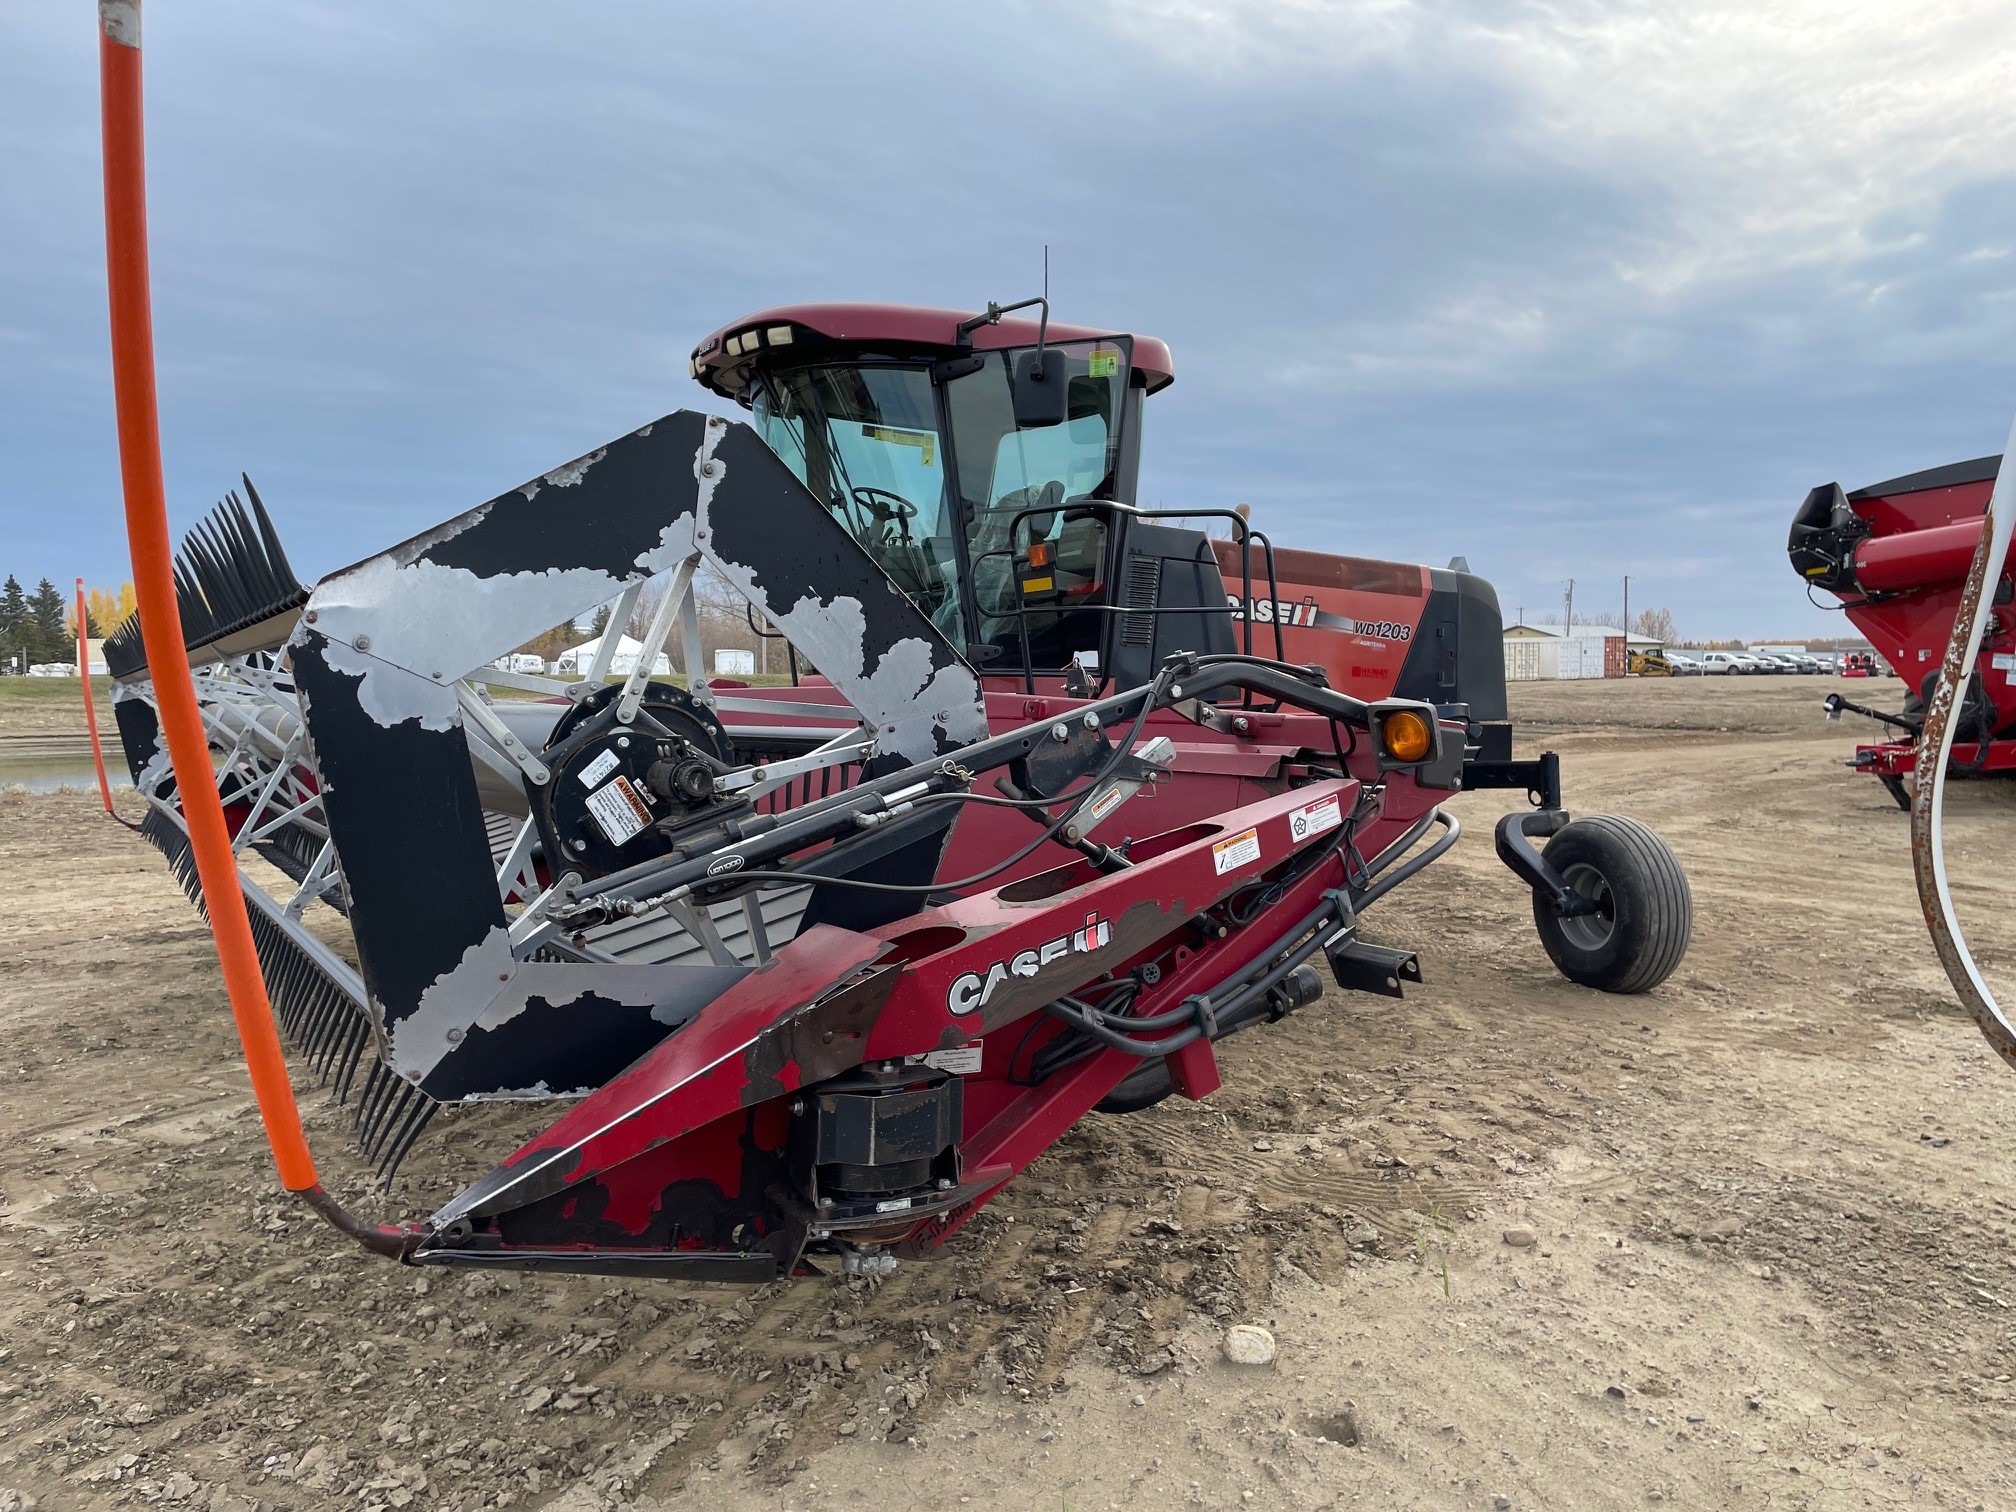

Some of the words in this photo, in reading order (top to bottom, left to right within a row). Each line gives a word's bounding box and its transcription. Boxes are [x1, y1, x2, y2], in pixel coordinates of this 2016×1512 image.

[1354, 620, 1411, 642] WD1203
[621, 785, 650, 823] WARNING
[1228, 834, 1247, 847] WARNING
